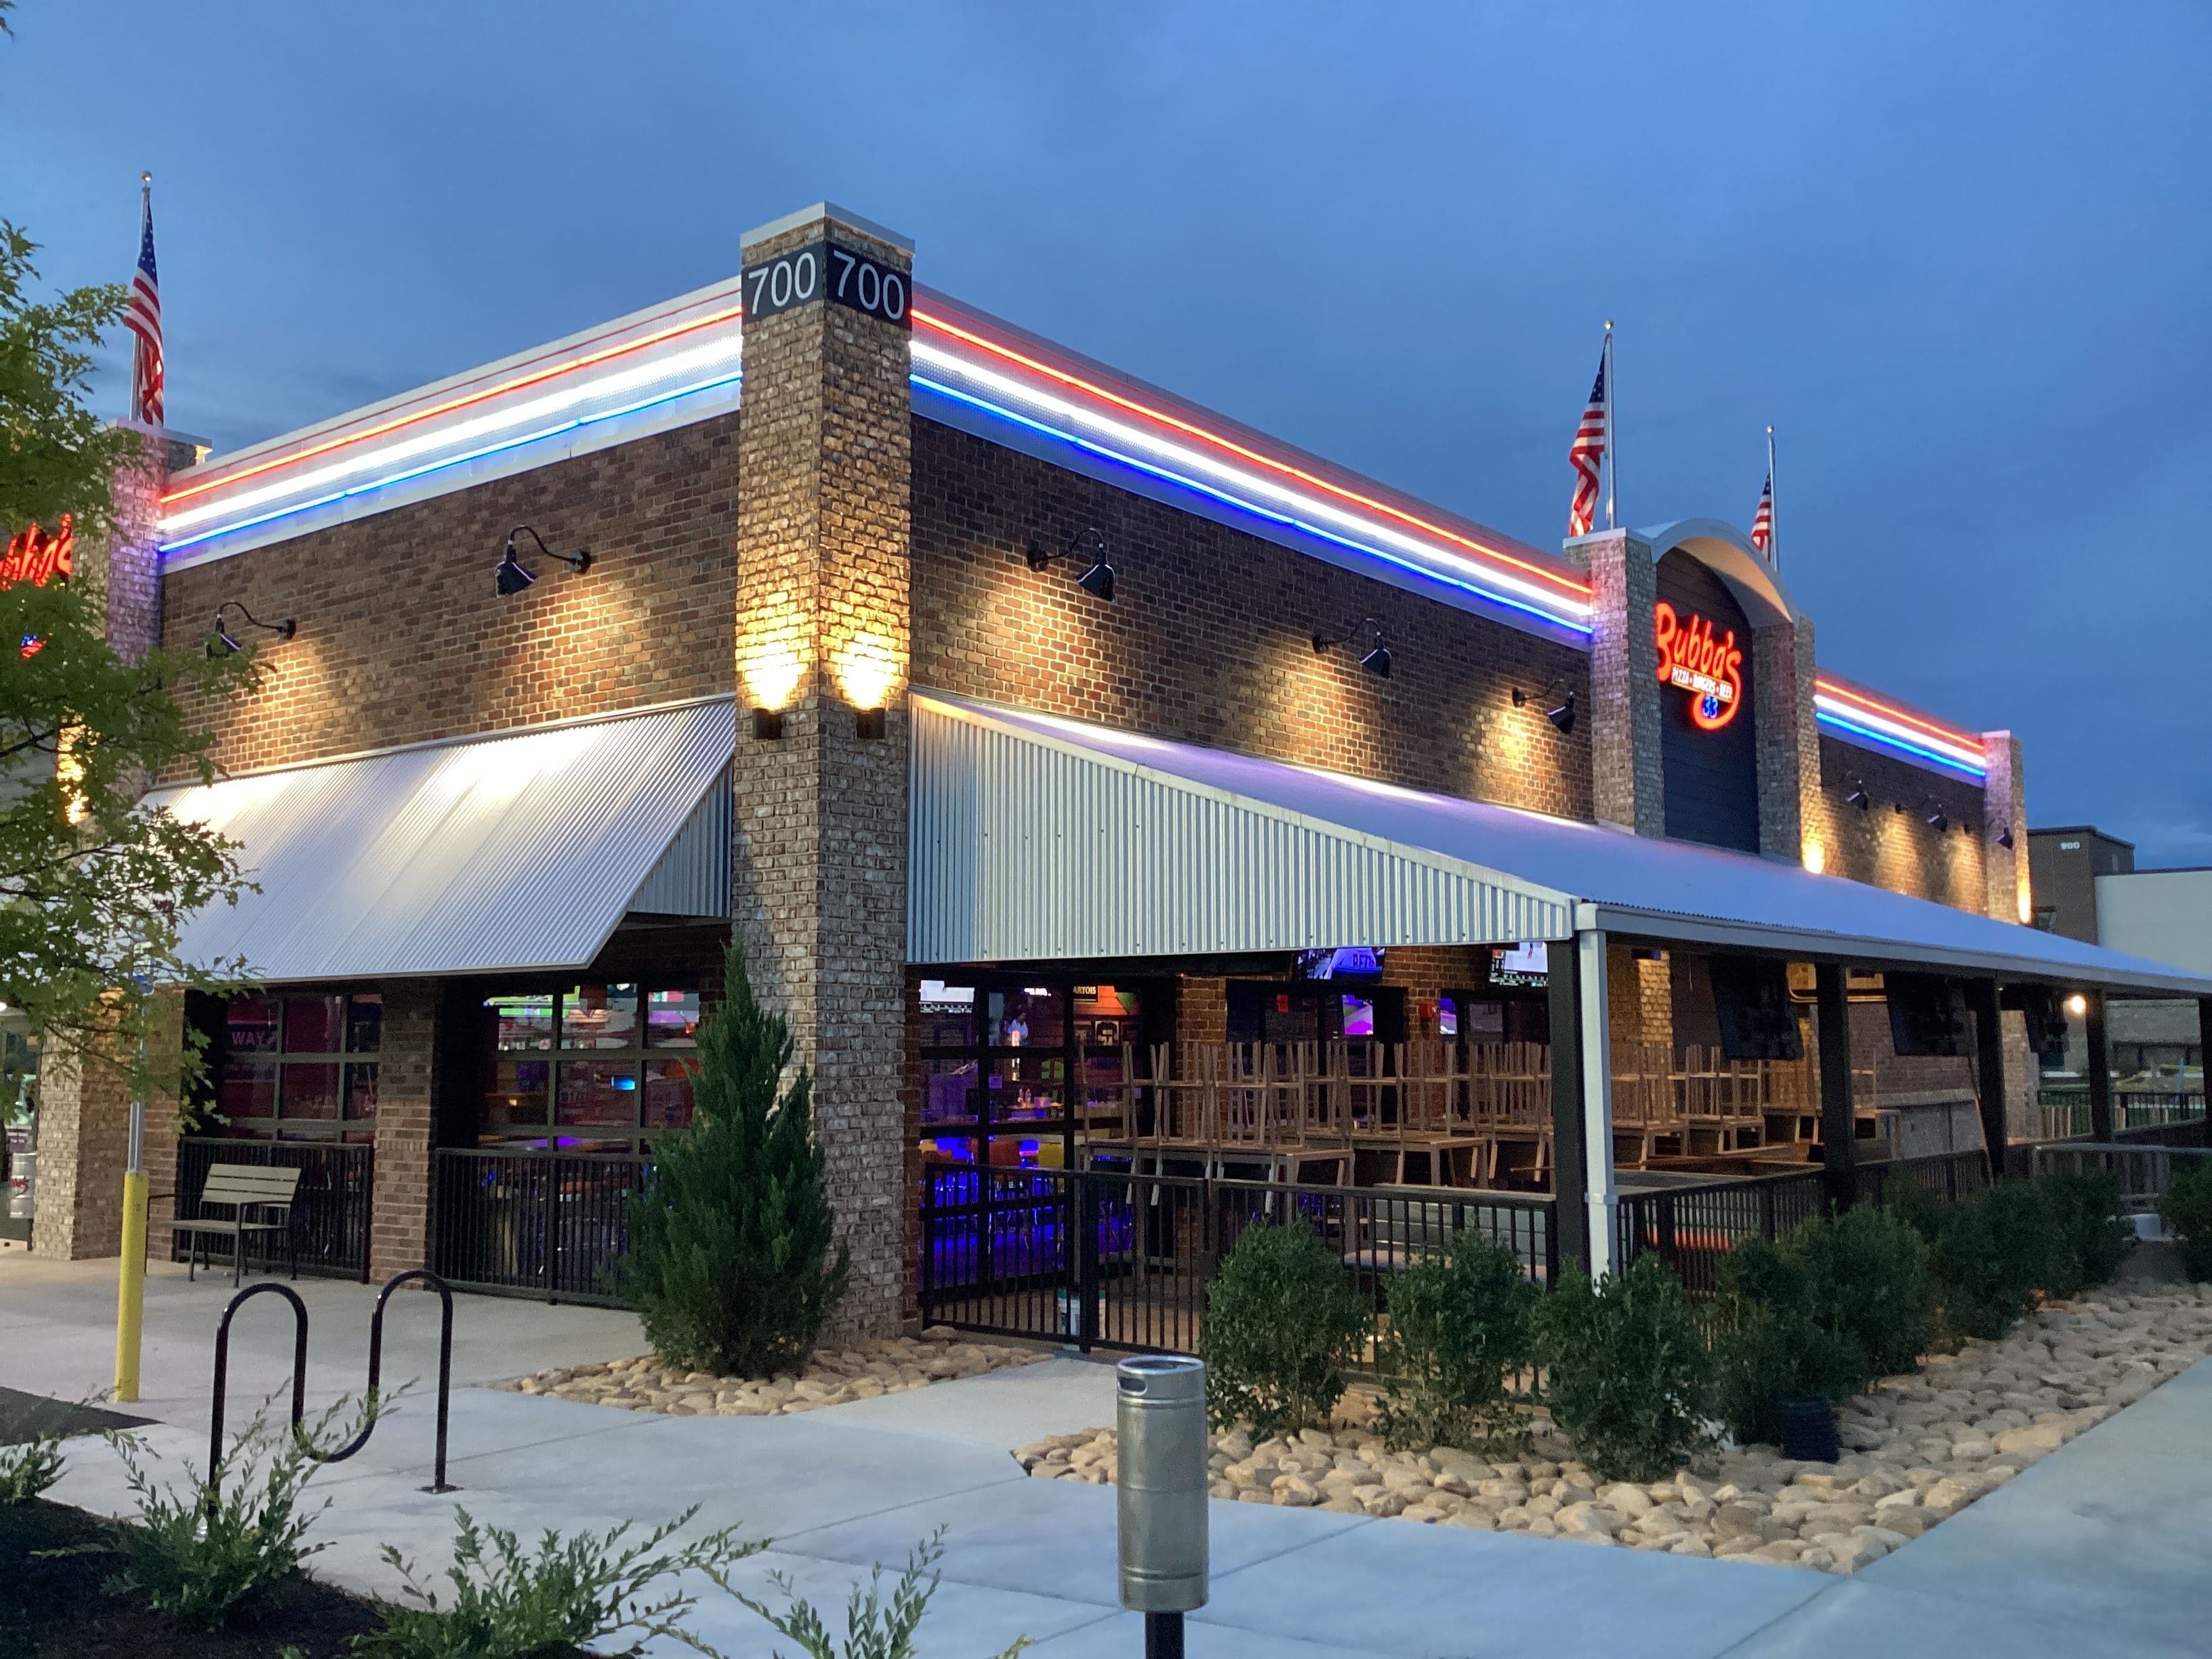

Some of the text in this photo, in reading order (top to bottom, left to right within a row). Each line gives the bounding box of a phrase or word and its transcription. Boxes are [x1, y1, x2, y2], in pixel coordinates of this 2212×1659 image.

[748, 252, 815, 314] 700
[834, 249, 904, 320] 700
[1656, 602, 1742, 682] Bubba's
[1672, 666, 1689, 684] PIZZA
[1702, 695, 1719, 719] 33
[1073, 985, 1096, 995] ARTOIS
